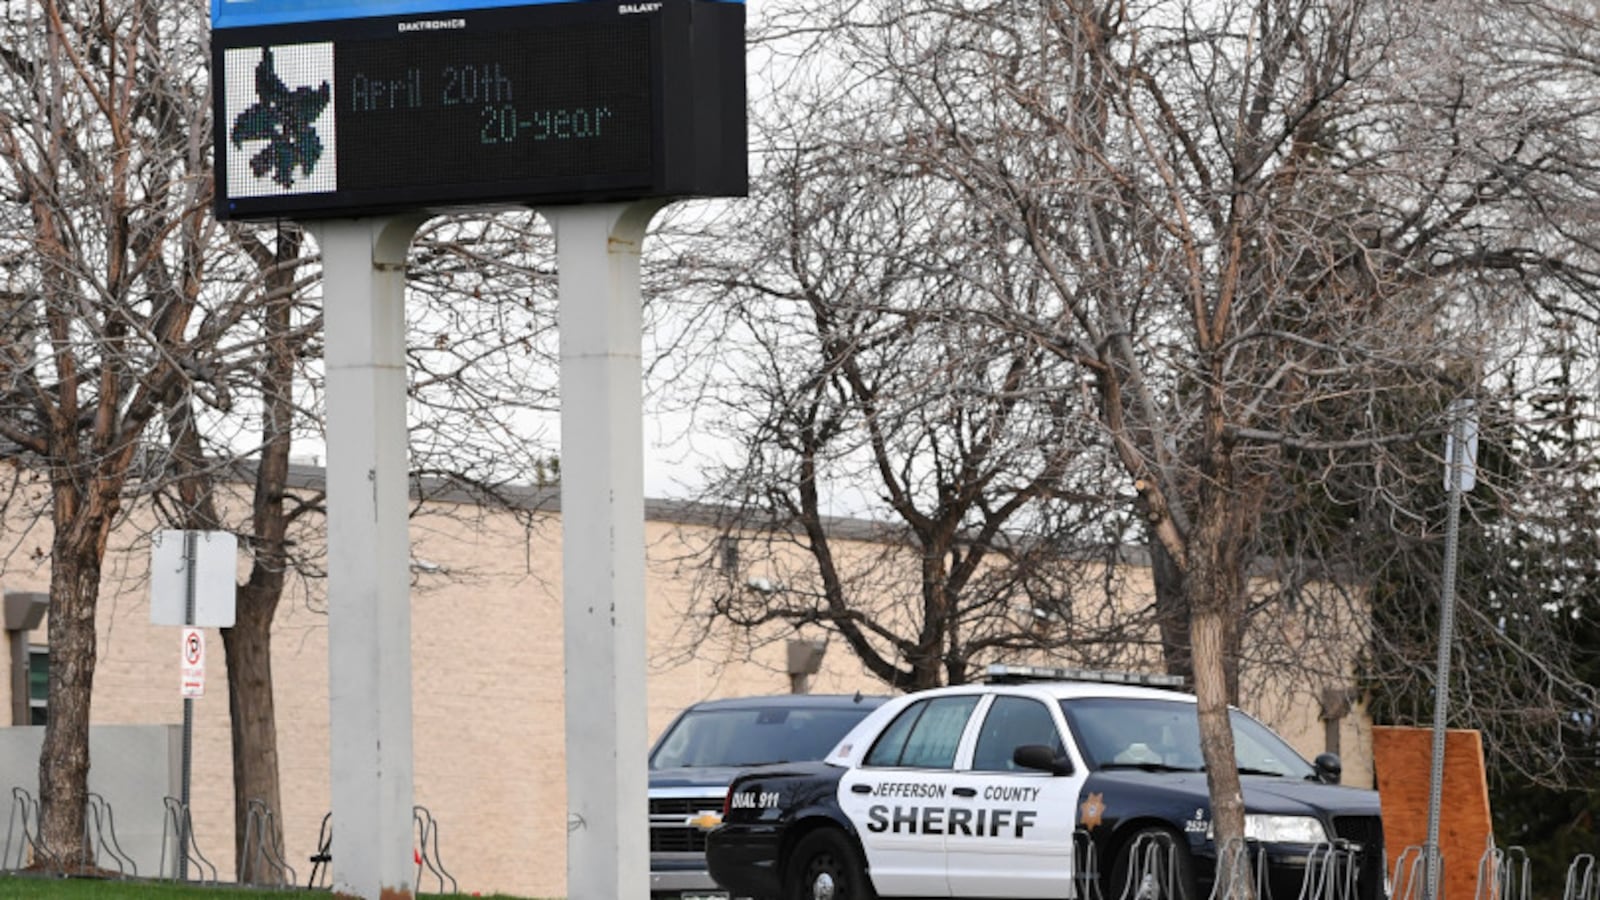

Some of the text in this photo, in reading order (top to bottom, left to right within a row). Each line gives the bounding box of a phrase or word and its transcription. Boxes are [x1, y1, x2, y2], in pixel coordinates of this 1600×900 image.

[398, 19, 466, 32] DAKTRONICS
[352, 63, 512, 111] April 20th
[480, 104, 612, 144] 20-year
[731, 792, 780, 808] DIAL 911
[872, 783, 1041, 801] JEFFERSON COUNTY
[867, 805, 1038, 838] SHERIFF
